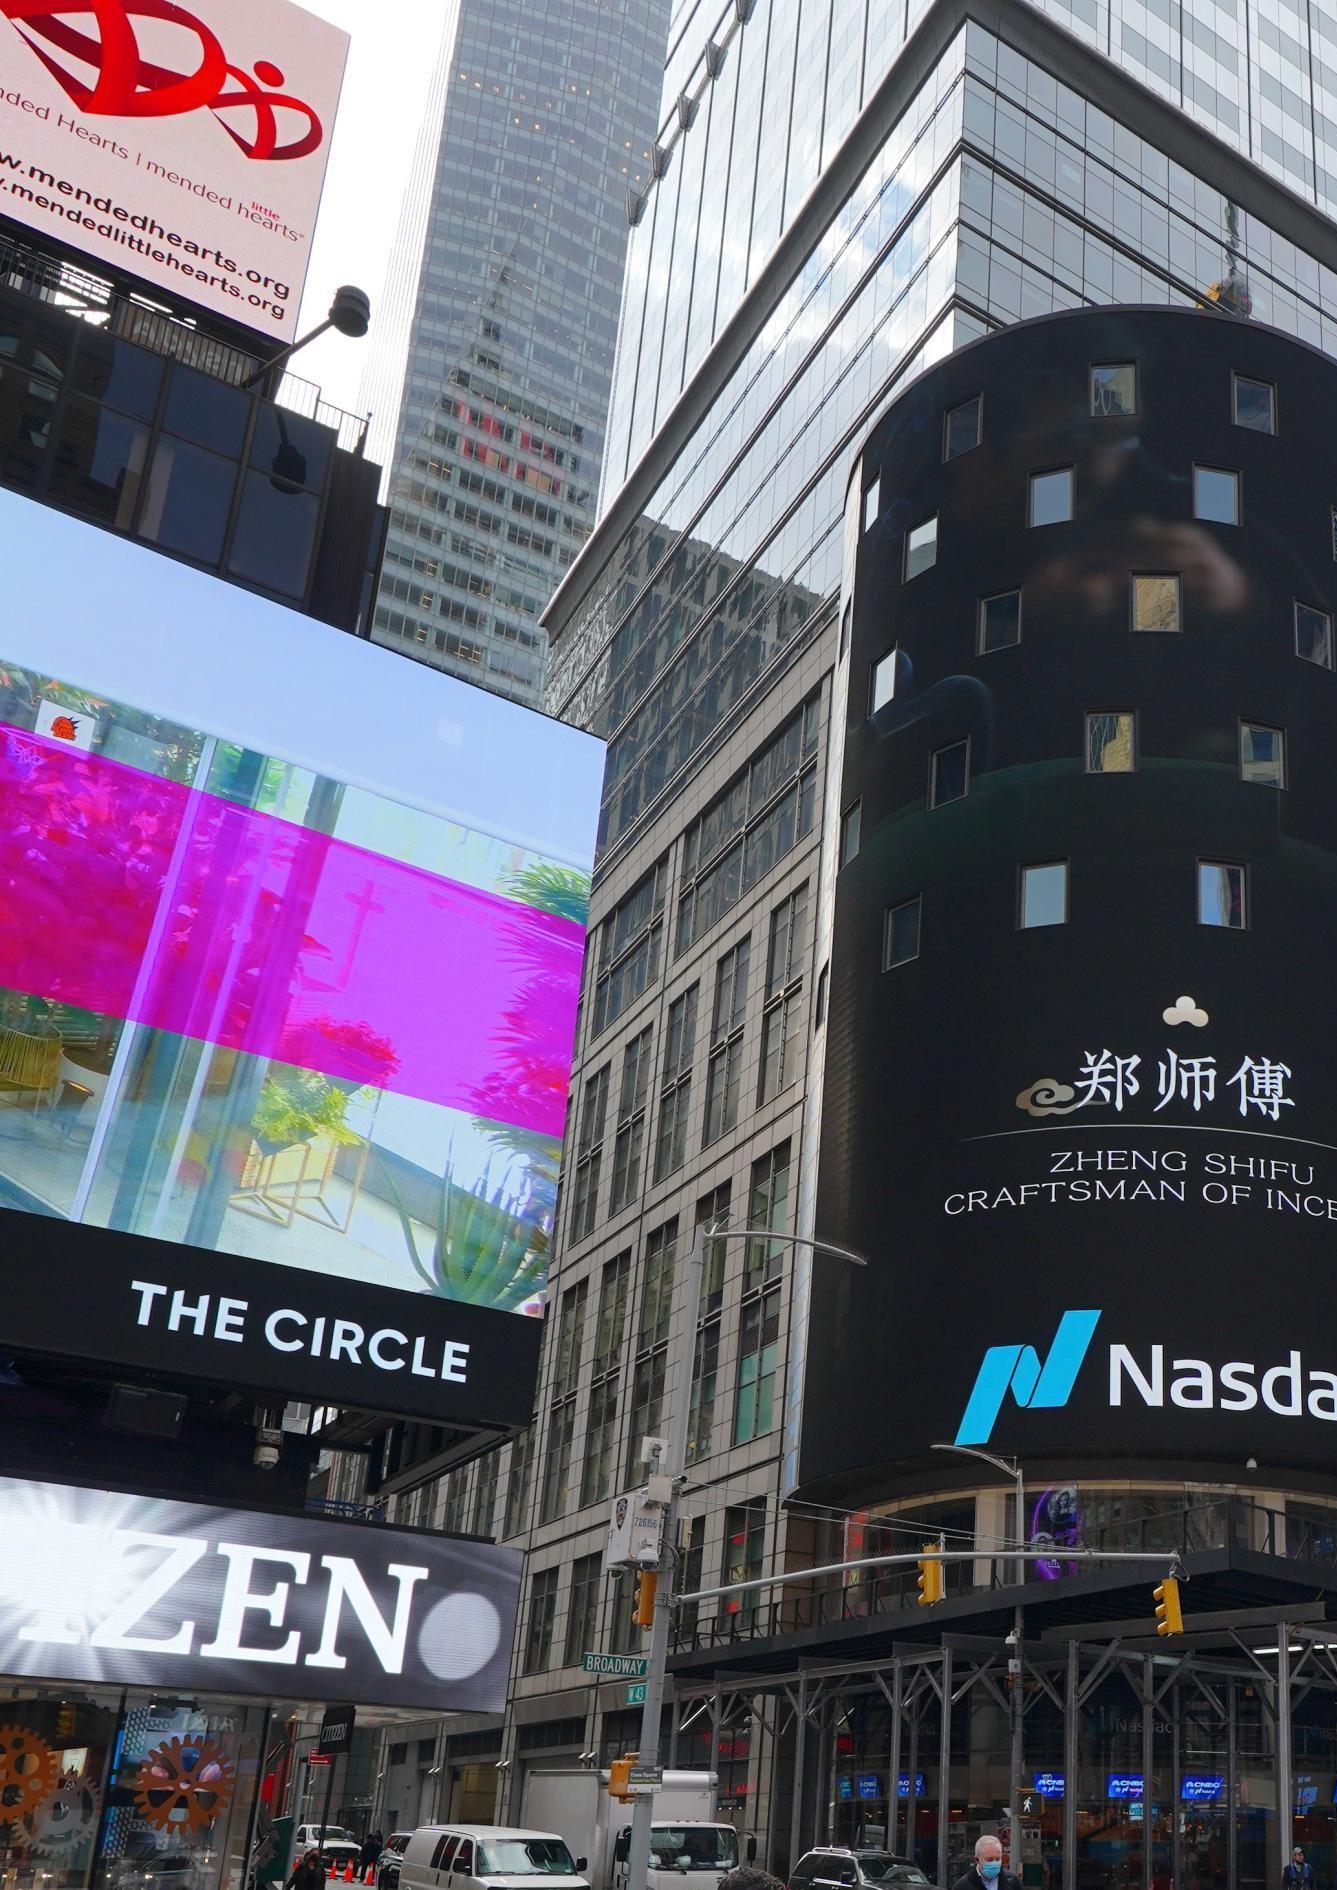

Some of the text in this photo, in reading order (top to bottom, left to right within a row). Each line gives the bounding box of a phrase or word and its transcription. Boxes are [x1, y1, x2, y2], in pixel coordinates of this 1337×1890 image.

[57, 113, 129, 160] Hearts
[146, 158, 231, 210] mended
[251, 201, 280, 221] little
[1074, 1048, 1295, 1121] 郑师傅
[1050, 1150, 1314, 1185] ZHENG SHIFU
[944, 1180, 1186, 1215] CRAFTSMAN
[1202, 1183, 1251, 1205] OF
[131, 1280, 471, 1384] THE CIRCLE
[634, 1517, 657, 1529] 726156
[586, 1655, 643, 1675] BROADWAY
[629, 1687, 643, 1702] W 43
[322, 1723, 347, 1742] CITIZEN
